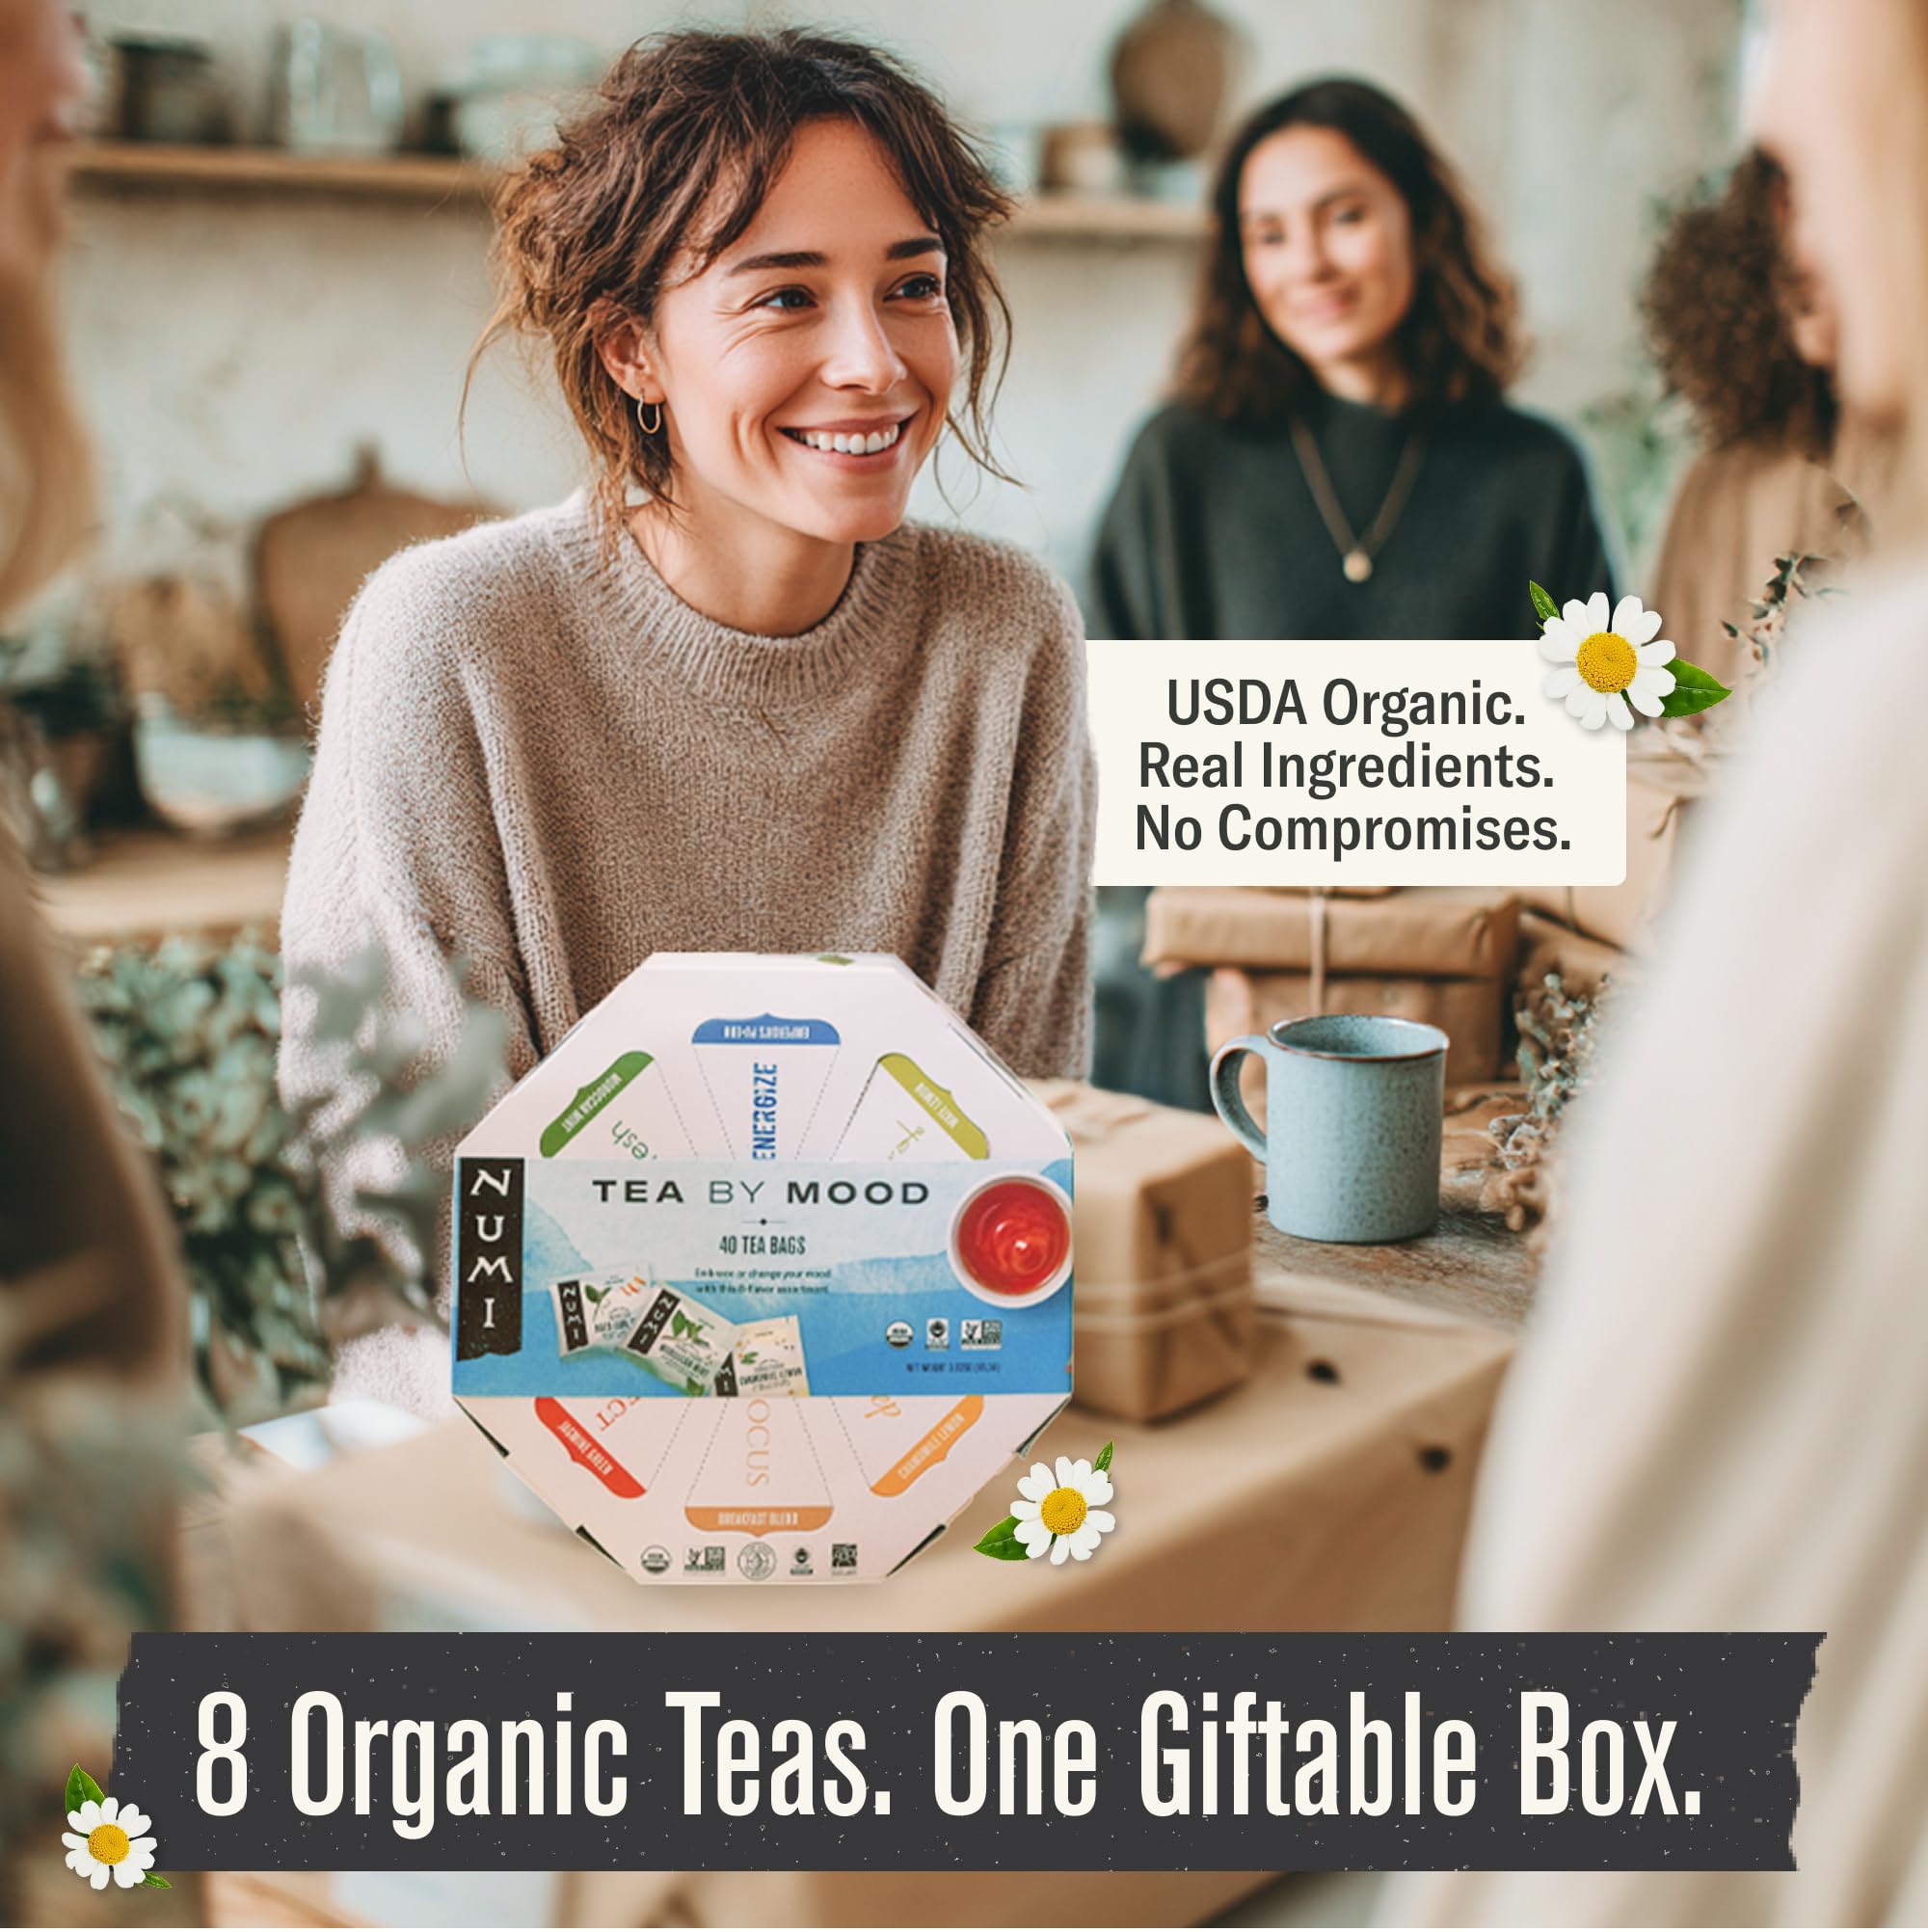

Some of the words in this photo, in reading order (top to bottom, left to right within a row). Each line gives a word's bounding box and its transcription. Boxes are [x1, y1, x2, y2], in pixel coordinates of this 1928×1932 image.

[752, 1061, 778, 1161] ENERGIZE
[611, 1120, 658, 1160] esh
[591, 1179, 685, 1204] TEA
[709, 1180, 765, 1205] BY
[787, 1180, 930, 1205] MOOD
[467, 1168, 514, 1328] NUMI
[719, 1235, 737, 1255] 40
[741, 1235, 765, 1255] TEA
[770, 1235, 806, 1255] BAGS
[562, 1285, 583, 1341] NUMI
[638, 1297, 675, 1346] NUMI
[746, 1399, 770, 1487] OCUS
